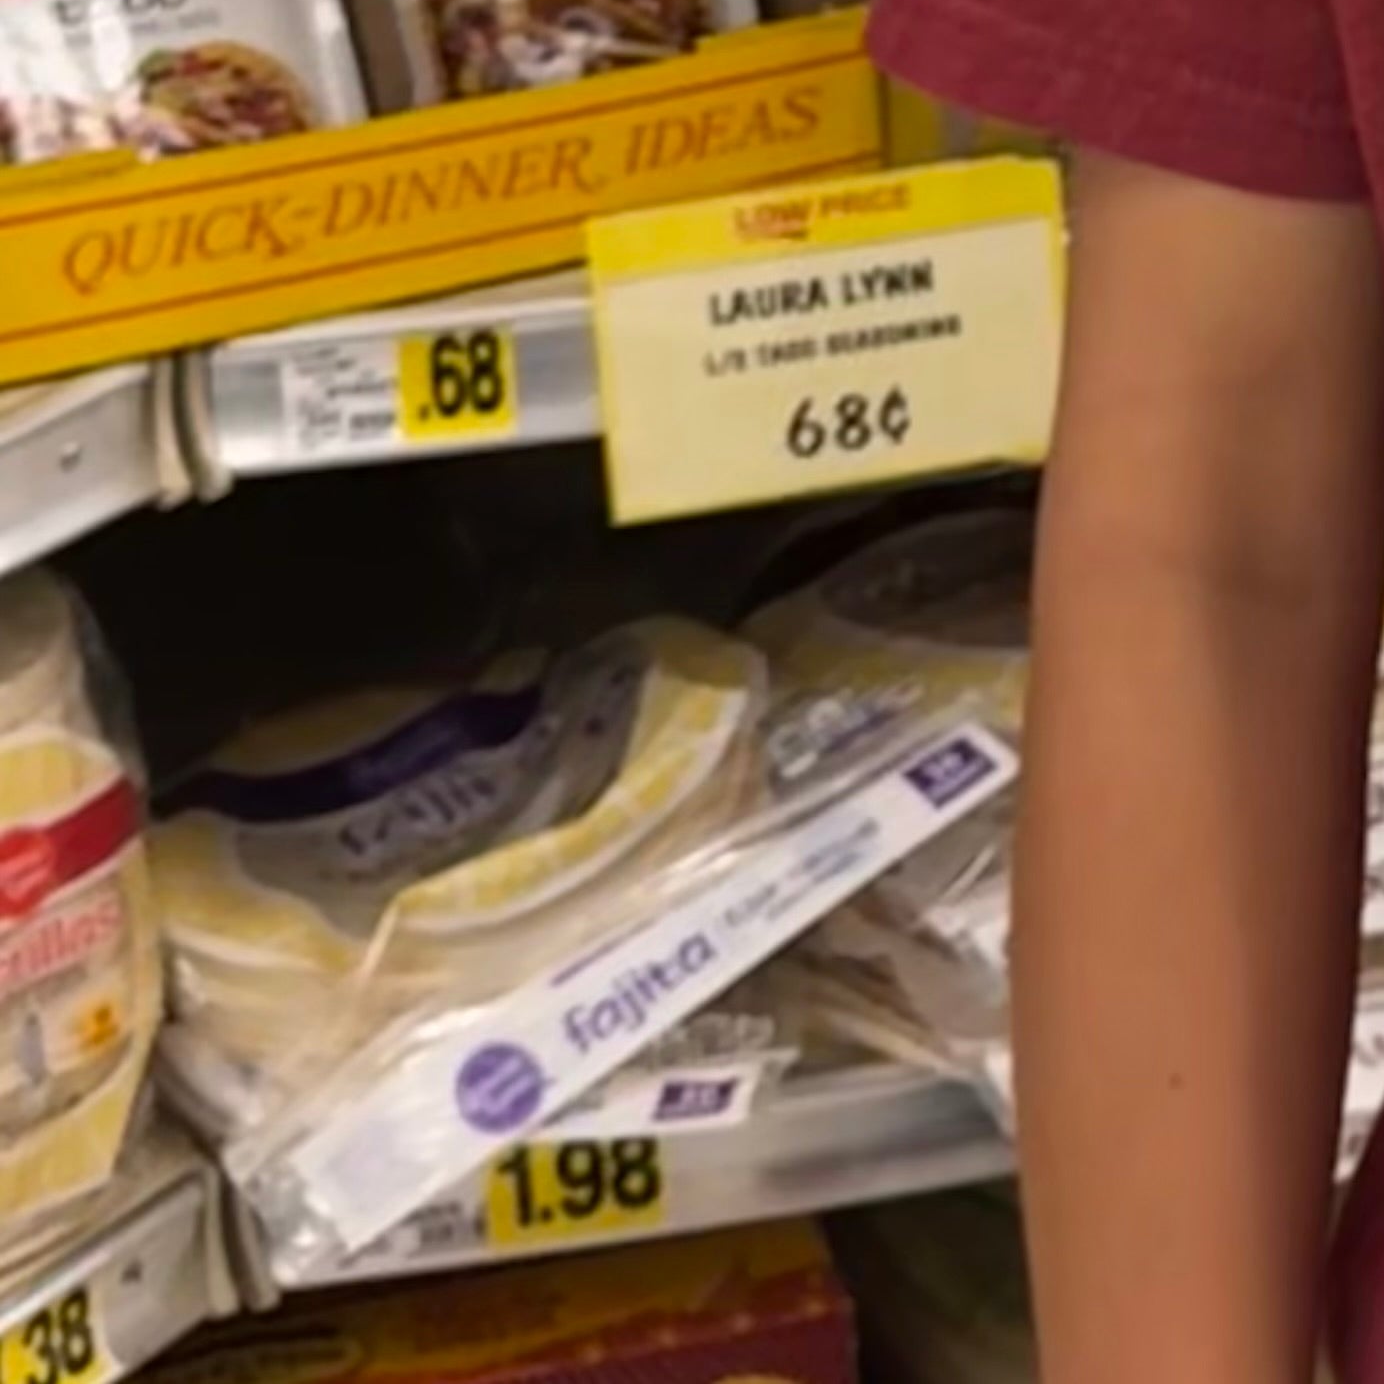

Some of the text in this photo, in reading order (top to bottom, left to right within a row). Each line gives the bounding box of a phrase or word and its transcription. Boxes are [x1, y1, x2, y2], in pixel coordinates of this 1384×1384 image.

[62, 85, 823, 296] QUICK-DINNER IDEAS
[709, 259, 935, 327] LAURA LYNN
[416, 330, 507, 424] .68
[784, 383, 910, 458] 68¢
[562, 925, 719, 1057] fajita
[494, 1136, 662, 1229] 1.98
